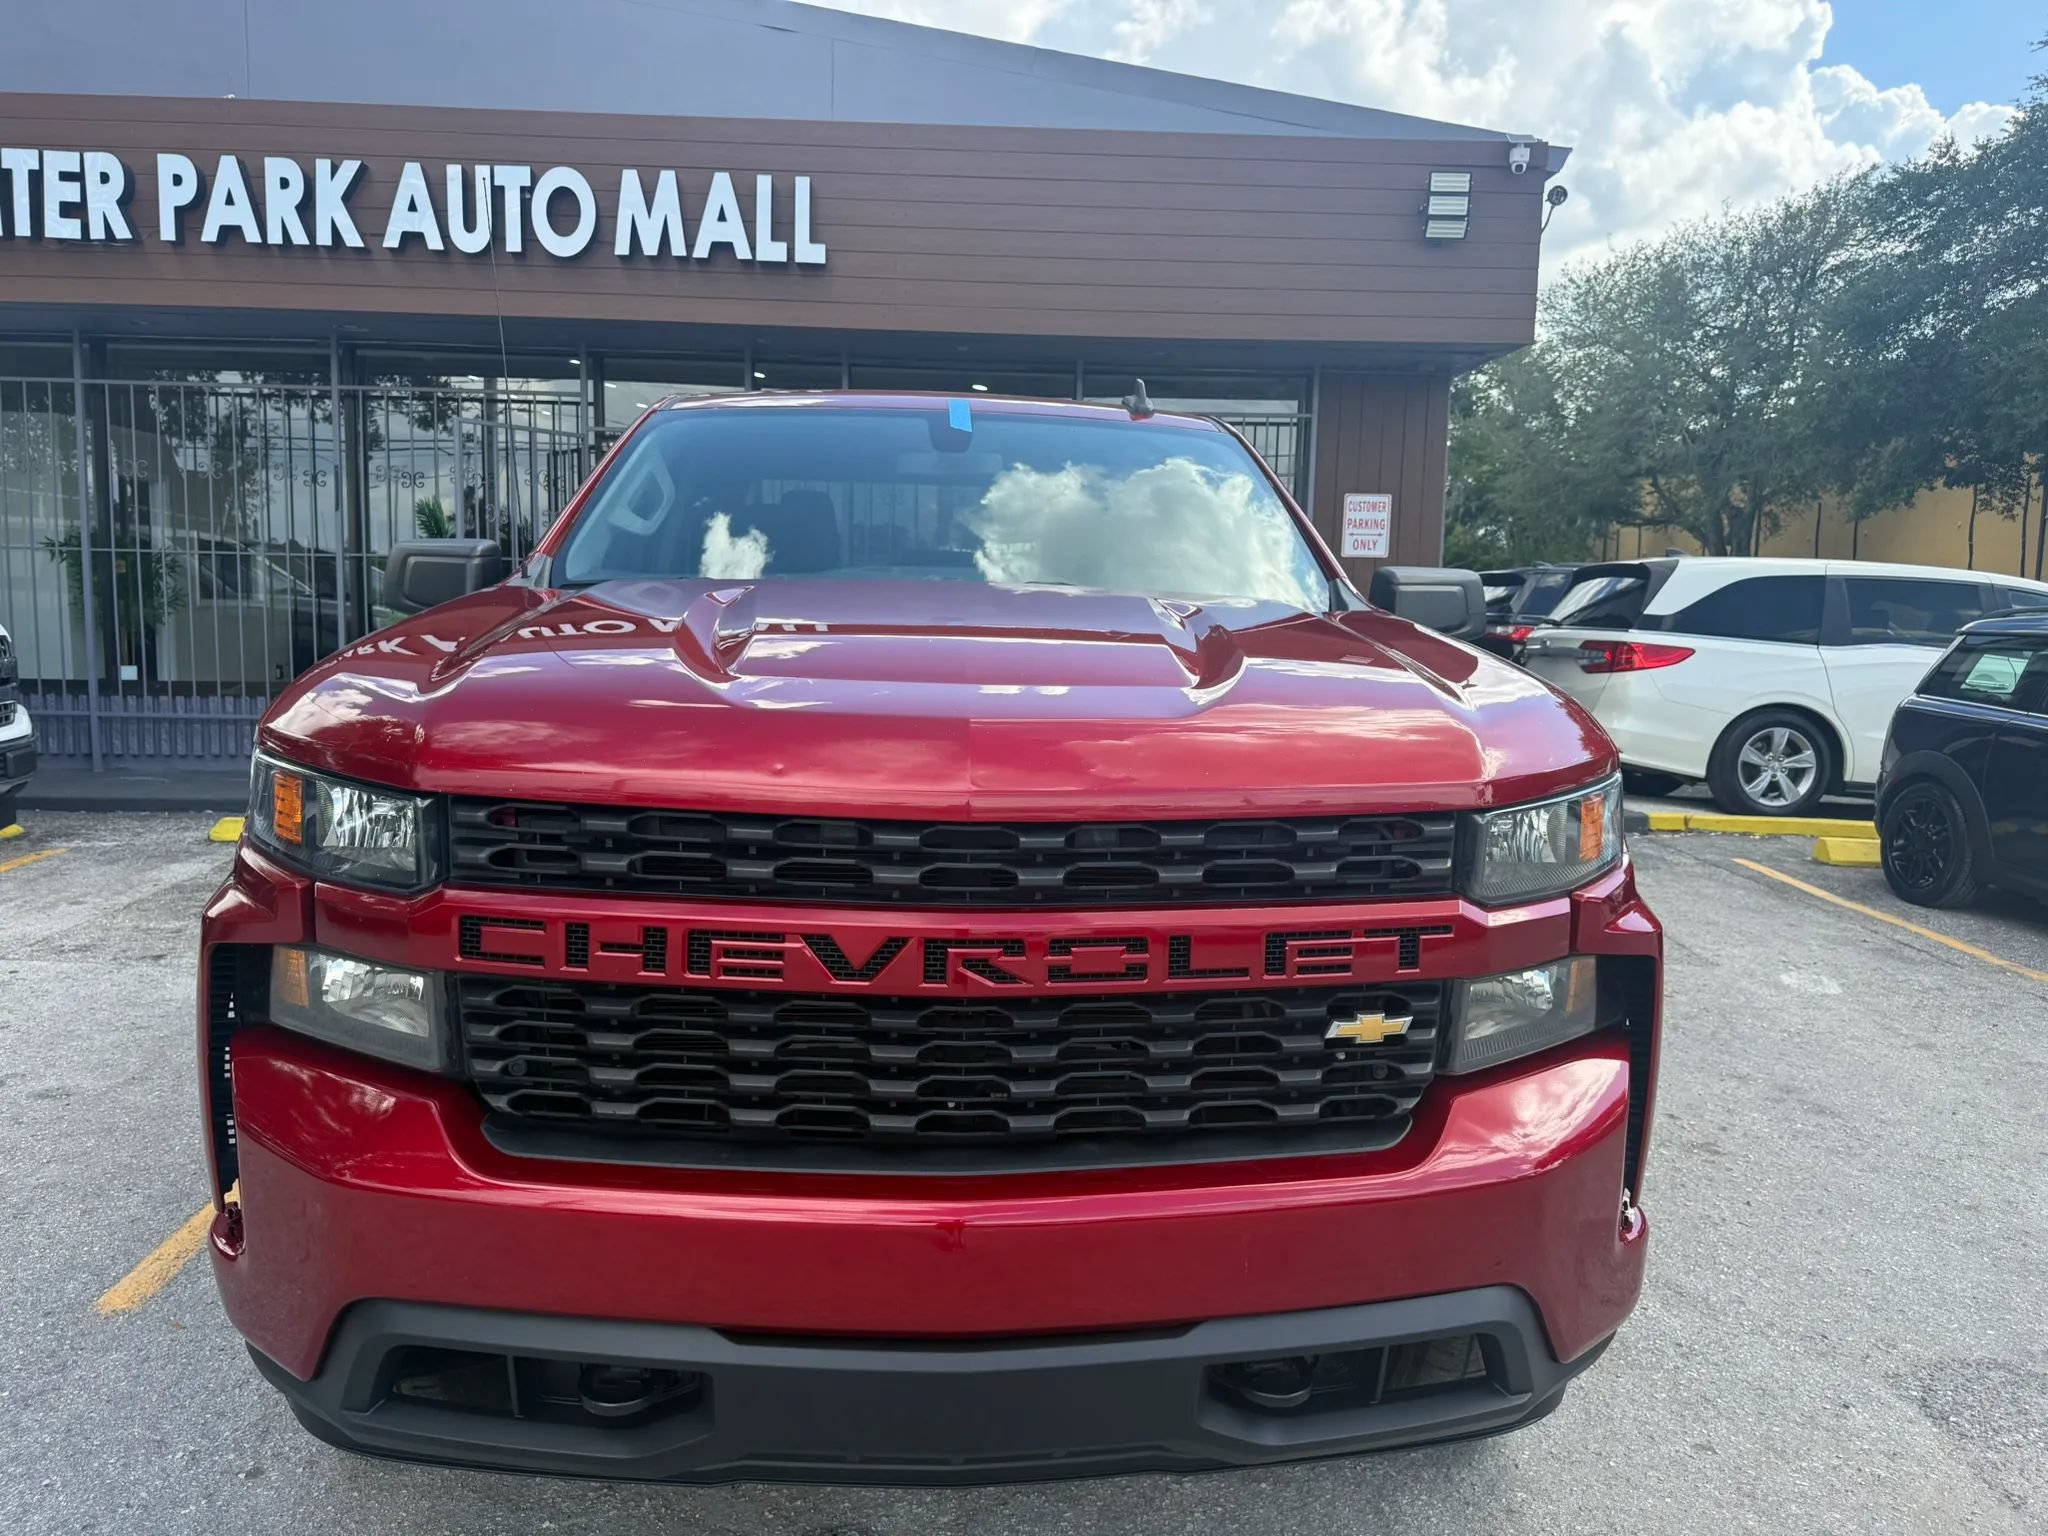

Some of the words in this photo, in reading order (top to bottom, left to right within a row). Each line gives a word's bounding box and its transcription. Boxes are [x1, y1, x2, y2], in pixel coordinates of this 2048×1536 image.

[0, 148, 133, 240] TER
[157, 153, 364, 248] PARK
[383, 162, 596, 258] AUTO
[614, 168, 826, 264] MALL
[1348, 500, 1387, 513] CUSTOMER
[1347, 519, 1385, 530] PARKING
[1353, 539, 1378, 551] ONLY
[458, 914, 1454, 985] CHEVROLET
